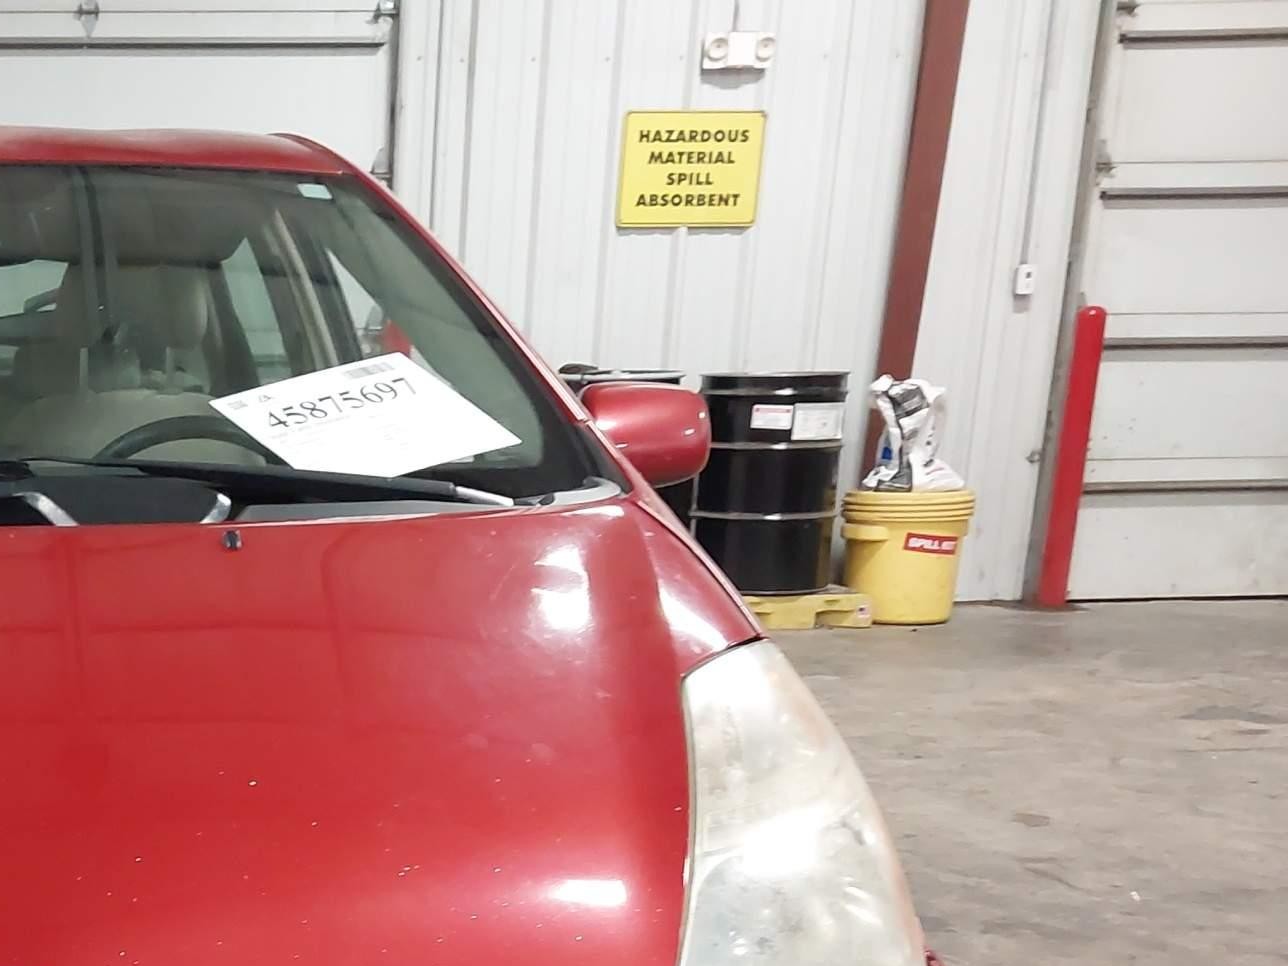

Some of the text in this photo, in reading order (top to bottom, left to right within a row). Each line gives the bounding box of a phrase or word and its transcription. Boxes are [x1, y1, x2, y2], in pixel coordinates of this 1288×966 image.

[638, 129, 750, 143] HAZARDOUS
[647, 151, 736, 164] MATERIAL
[665, 173, 714, 185] SPILL
[635, 194, 741, 207] ABSORBENT
[267, 376, 417, 428] 45875697
